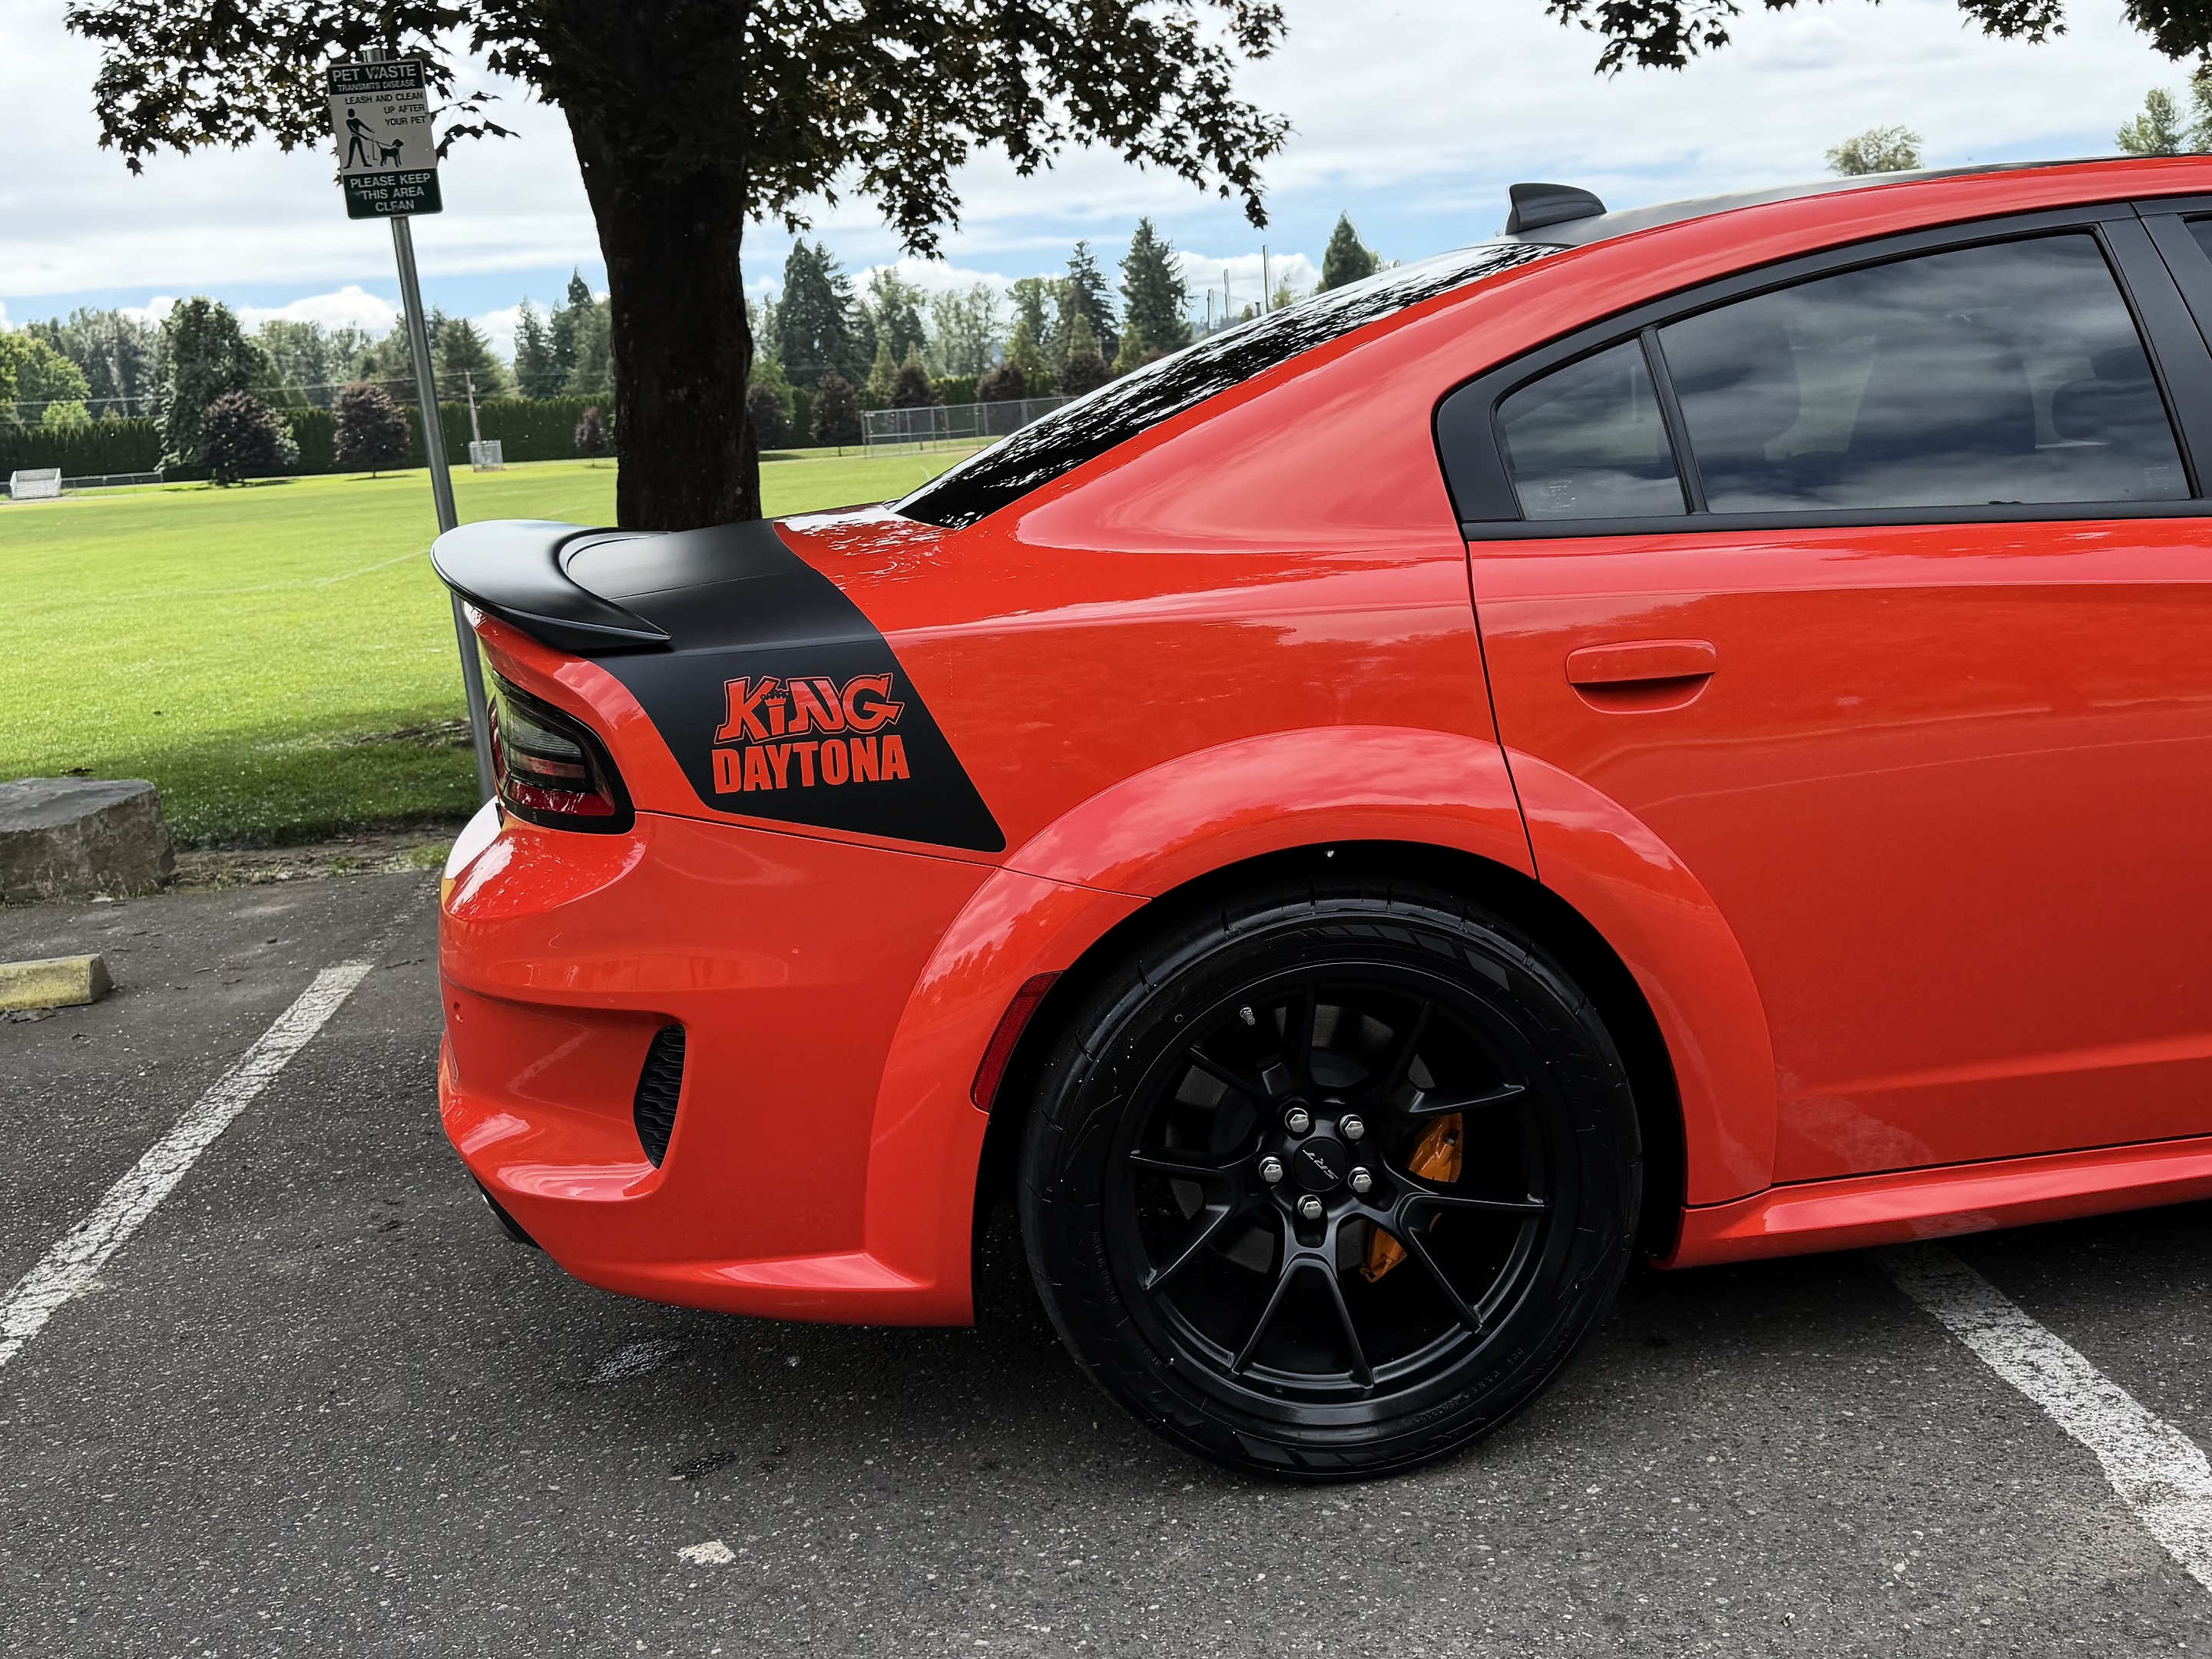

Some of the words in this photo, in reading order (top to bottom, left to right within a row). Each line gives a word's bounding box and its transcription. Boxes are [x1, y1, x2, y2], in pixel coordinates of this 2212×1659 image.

[332, 68, 360, 82] PET
[365, 65, 416, 79] WASTE
[337, 81, 381, 92] TRANSMITS
[382, 79, 416, 89] DISEASE
[345, 94, 373, 104] LEASH
[376, 94, 392, 102] AND
[396, 92, 423, 101] CLEAN
[384, 105, 396, 114] UP
[398, 104, 426, 113] AFTER
[385, 118, 408, 126] YOUR
[410, 115, 426, 124] PET
[350, 175, 396, 188] PLEASE
[399, 173, 431, 184] KEEP
[360, 188, 389, 200] THIS
[393, 186, 425, 198] AREA
[375, 200, 415, 212] CLEAN
[711, 734, 910, 794] DAYTONA
[1302, 1149, 1339, 1180] SRT
